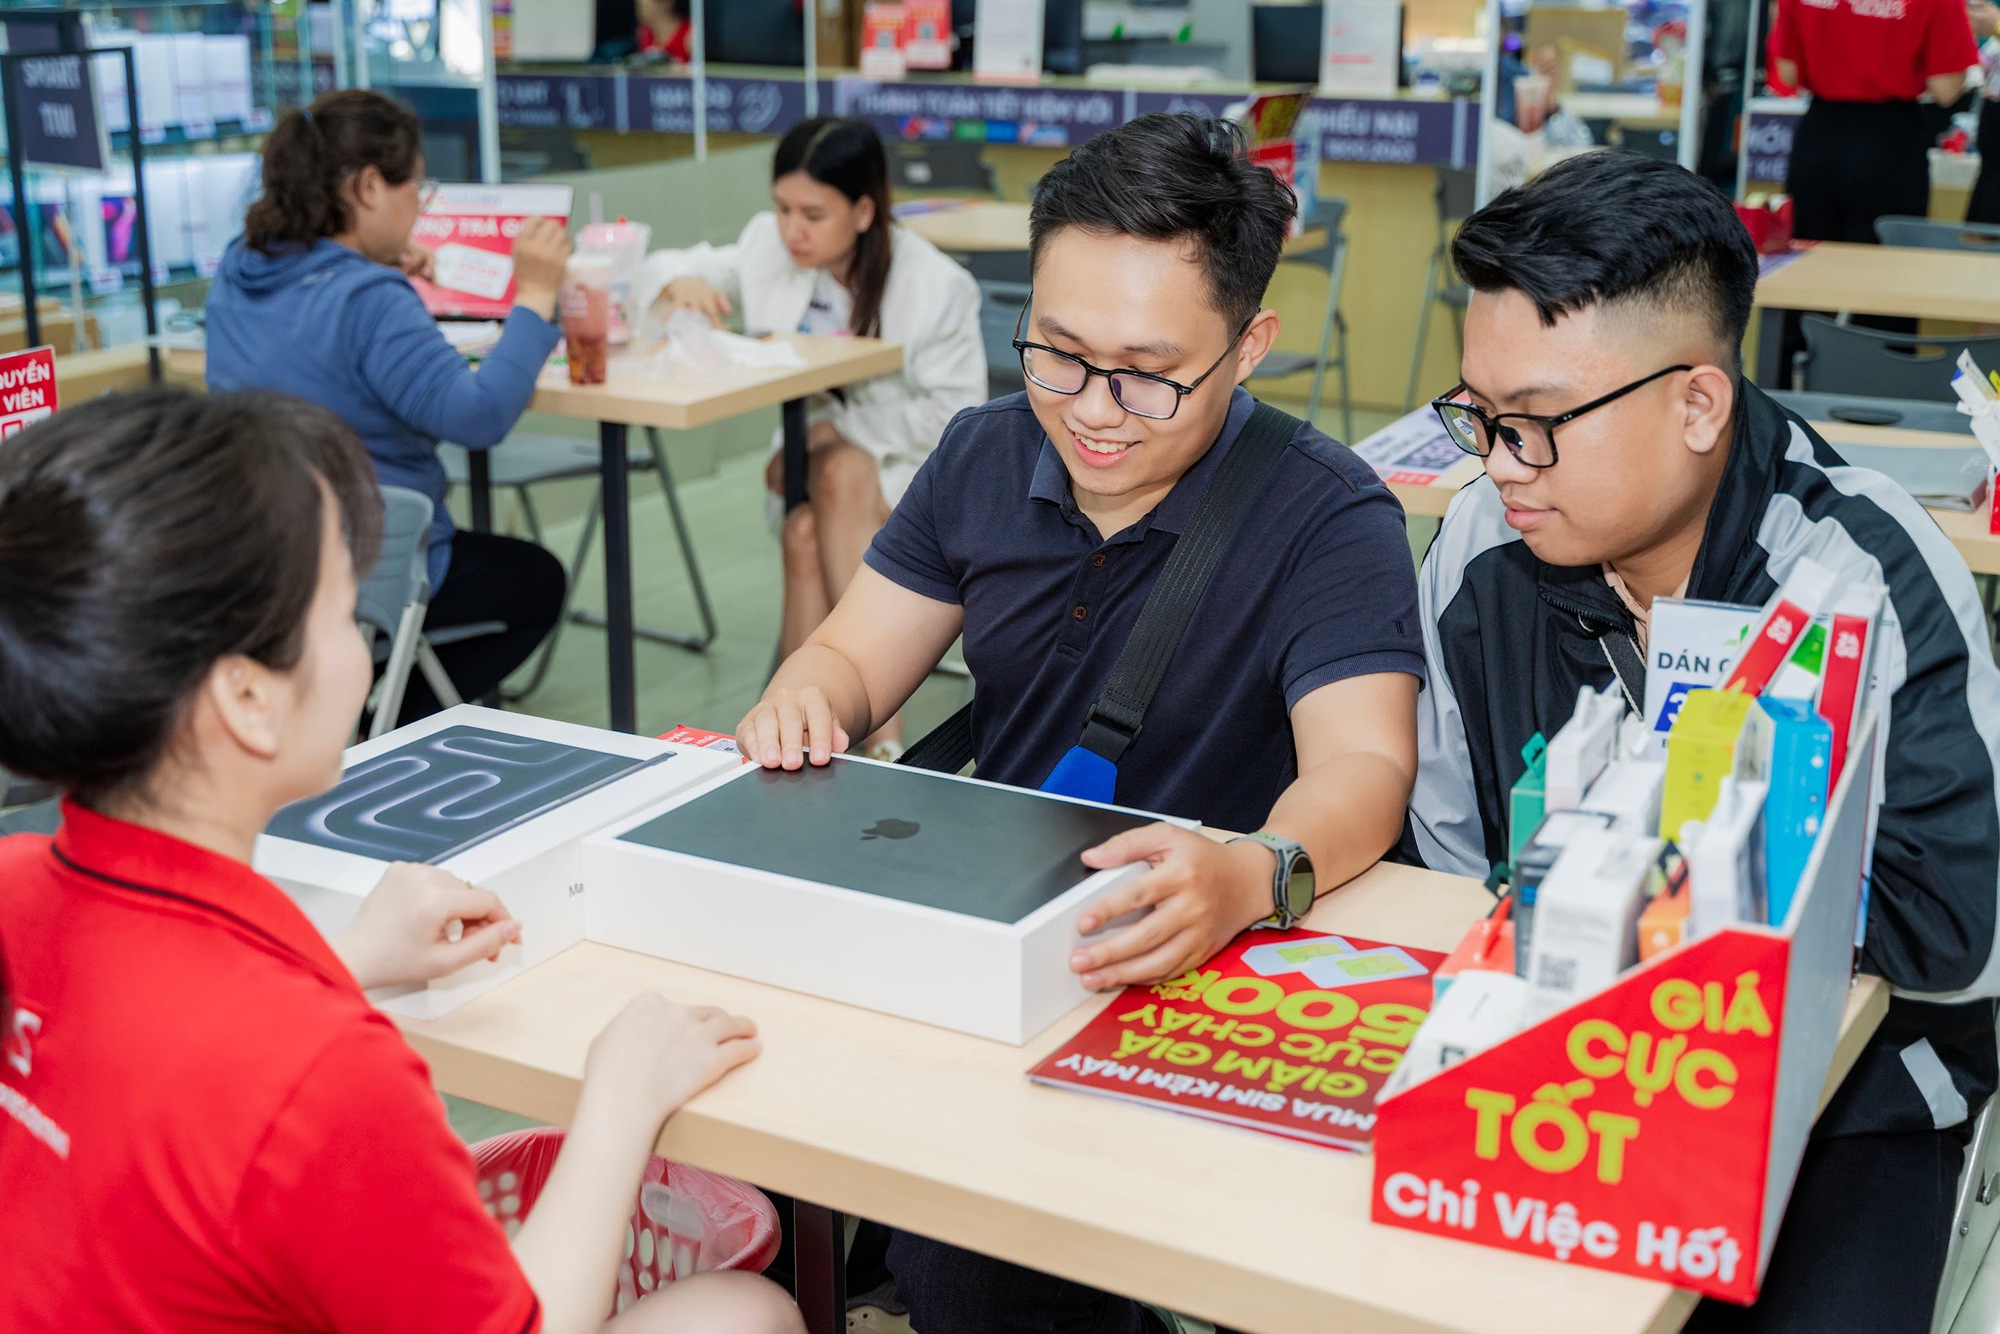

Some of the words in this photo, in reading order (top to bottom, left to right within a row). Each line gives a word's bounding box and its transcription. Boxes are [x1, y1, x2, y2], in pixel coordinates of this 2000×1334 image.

[2, 386, 45, 412] VIÊN
[1658, 649, 1710, 674] DÁN
[1650, 970, 1773, 1038] GIÁ
[1116, 1003, 1276, 1048] CHÁY
[1056, 1052, 1138, 1079] MÁY
[1111, 1028, 1213, 1066] GIÁ
[1278, 1033, 1405, 1074] CỰC
[1566, 1018, 1739, 1110] CỰC
[1137, 1070, 1217, 1100] KÈM
[1214, 1049, 1368, 1099] GIẢM
[1217, 1087, 1289, 1114] SIM
[1292, 1097, 1378, 1131] MUA
[1464, 1077, 1641, 1185] TỐT
[1382, 1171, 1482, 1231] Chỉ
[1492, 1190, 1620, 1262] Việc
[1635, 1220, 1742, 1284] Hốt
